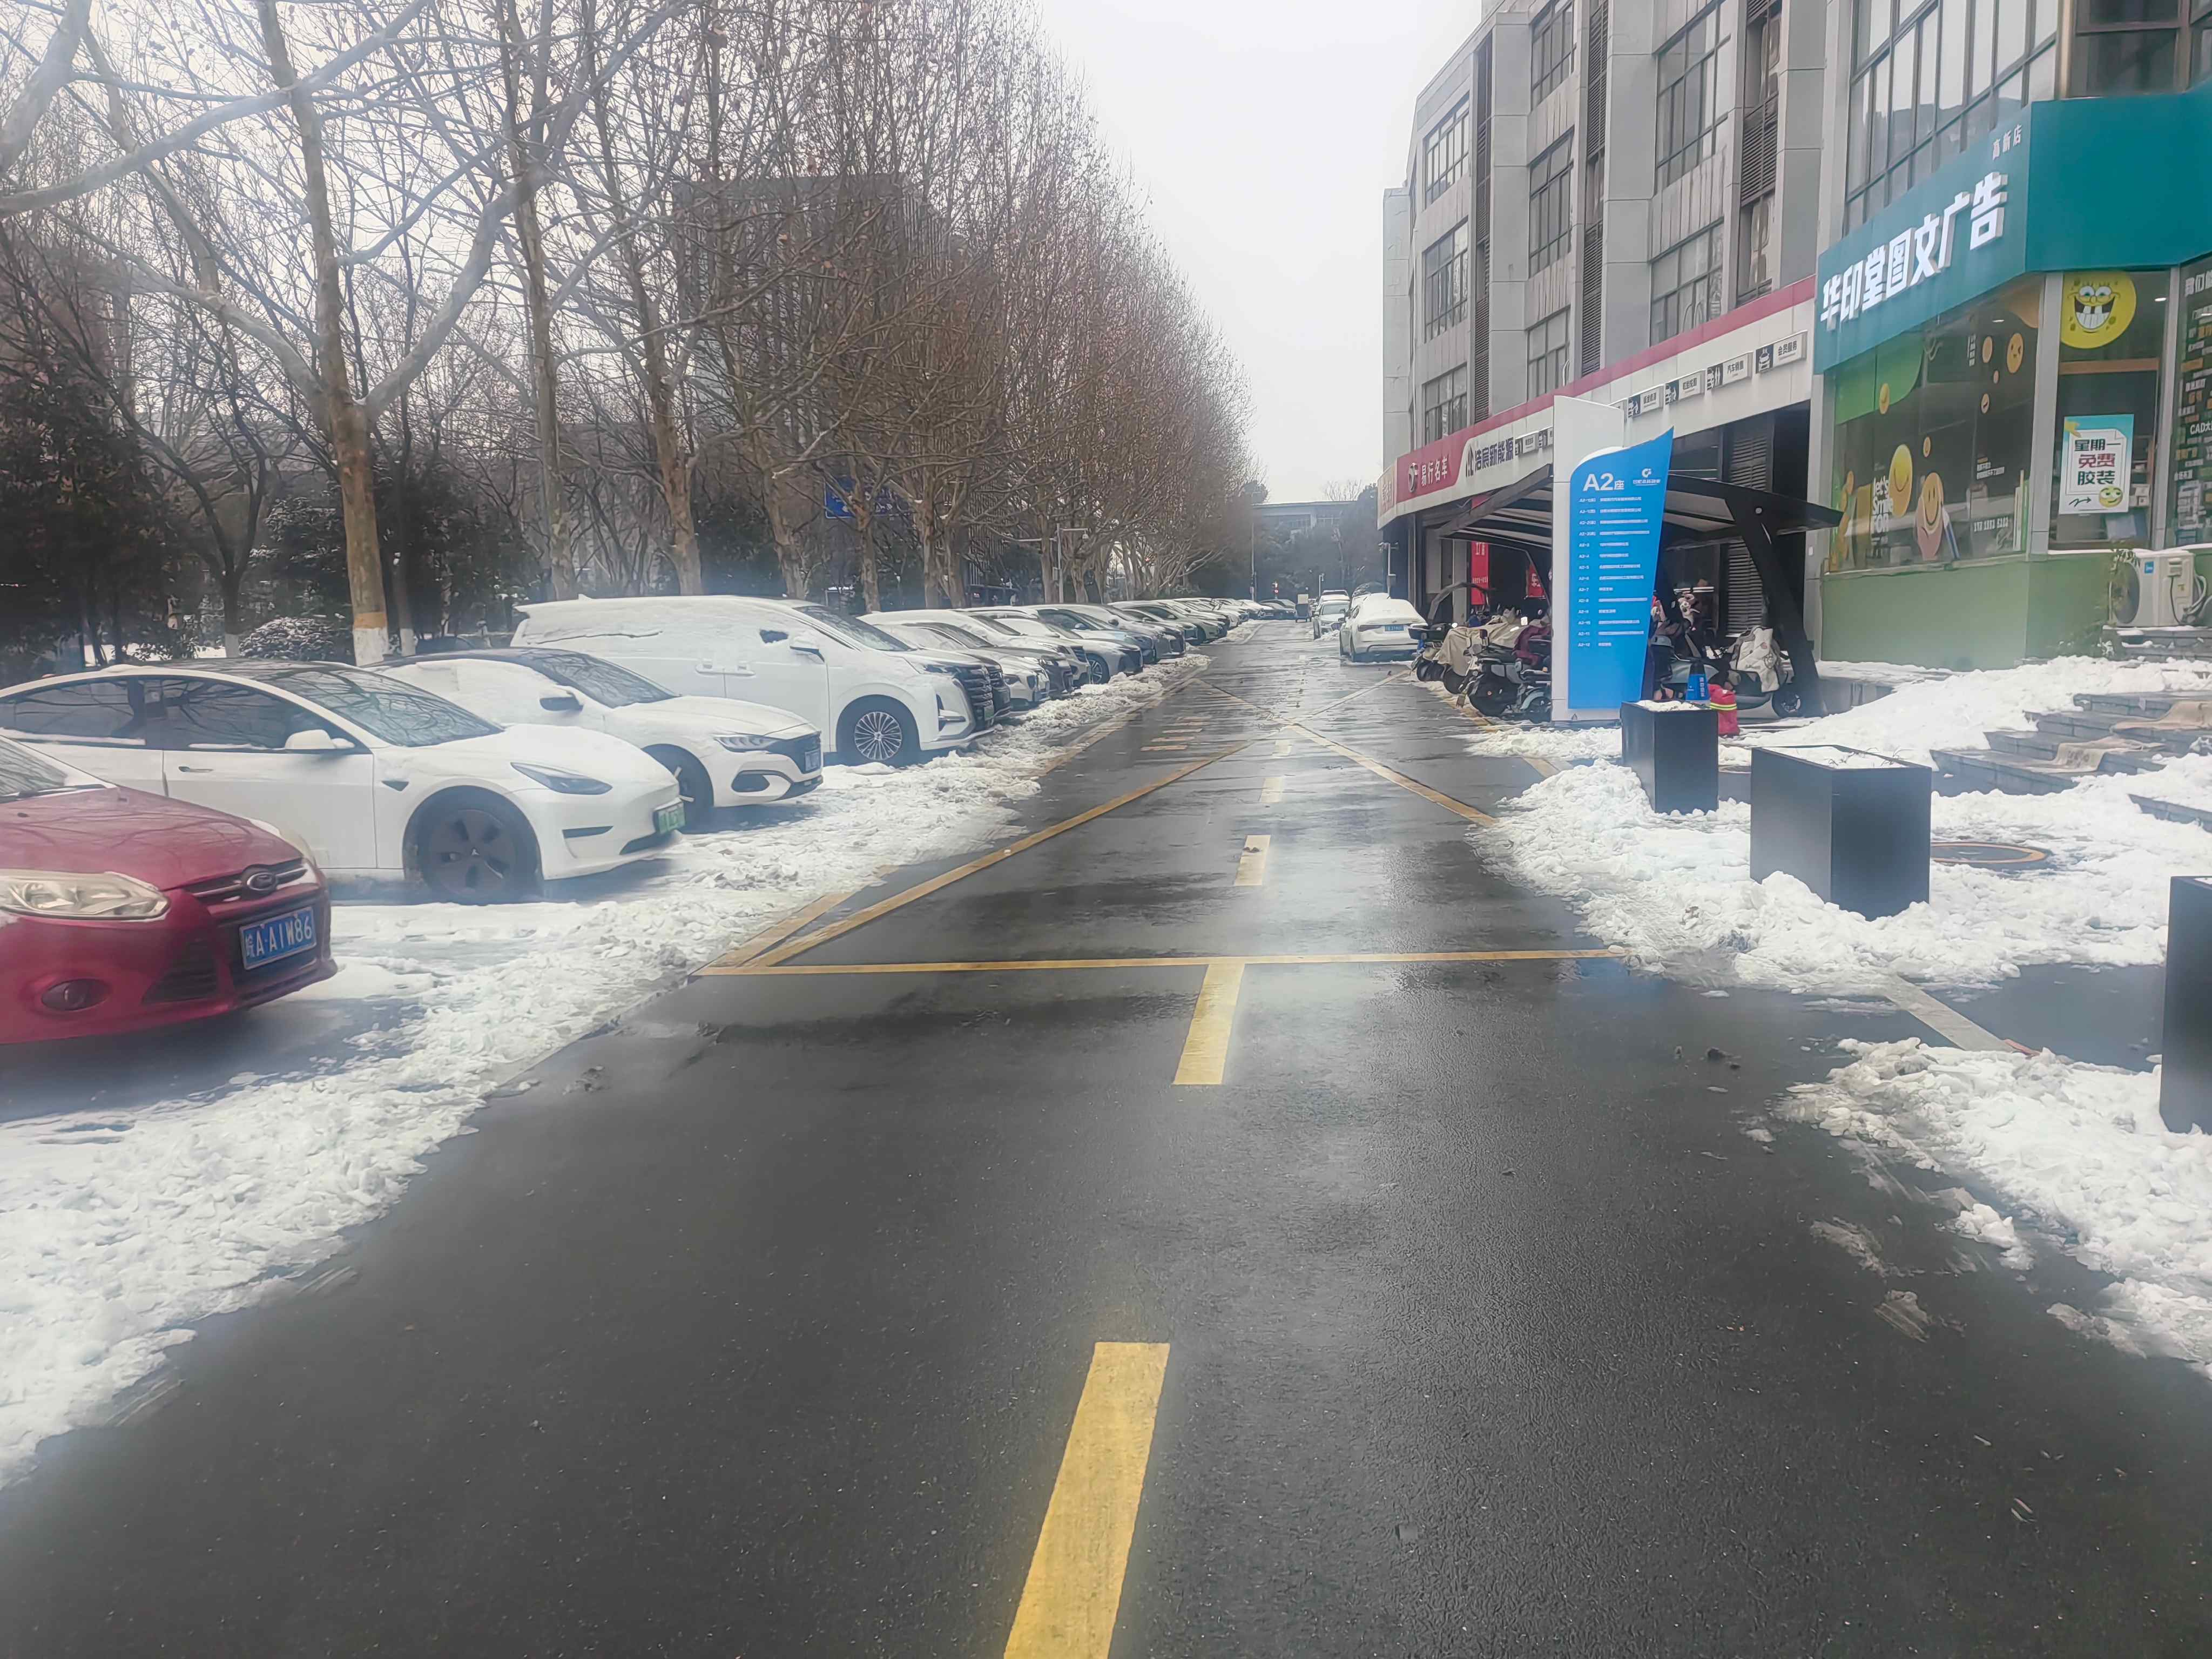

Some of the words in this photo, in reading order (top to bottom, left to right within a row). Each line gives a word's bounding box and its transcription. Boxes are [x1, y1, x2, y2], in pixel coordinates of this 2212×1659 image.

[1993, 124, 2022, 160] 高新店
[1820, 172, 2008, 332] 华印堂图文广告
[1777, 340, 1798, 356] 会员服务
[2074, 439, 2121, 452] 星期一
[2078, 453, 2116, 469] 免费
[1421, 457, 1448, 487] 易行名车
[2077, 470, 2116, 486] 胶装
[1582, 473, 1625, 492] A2座
